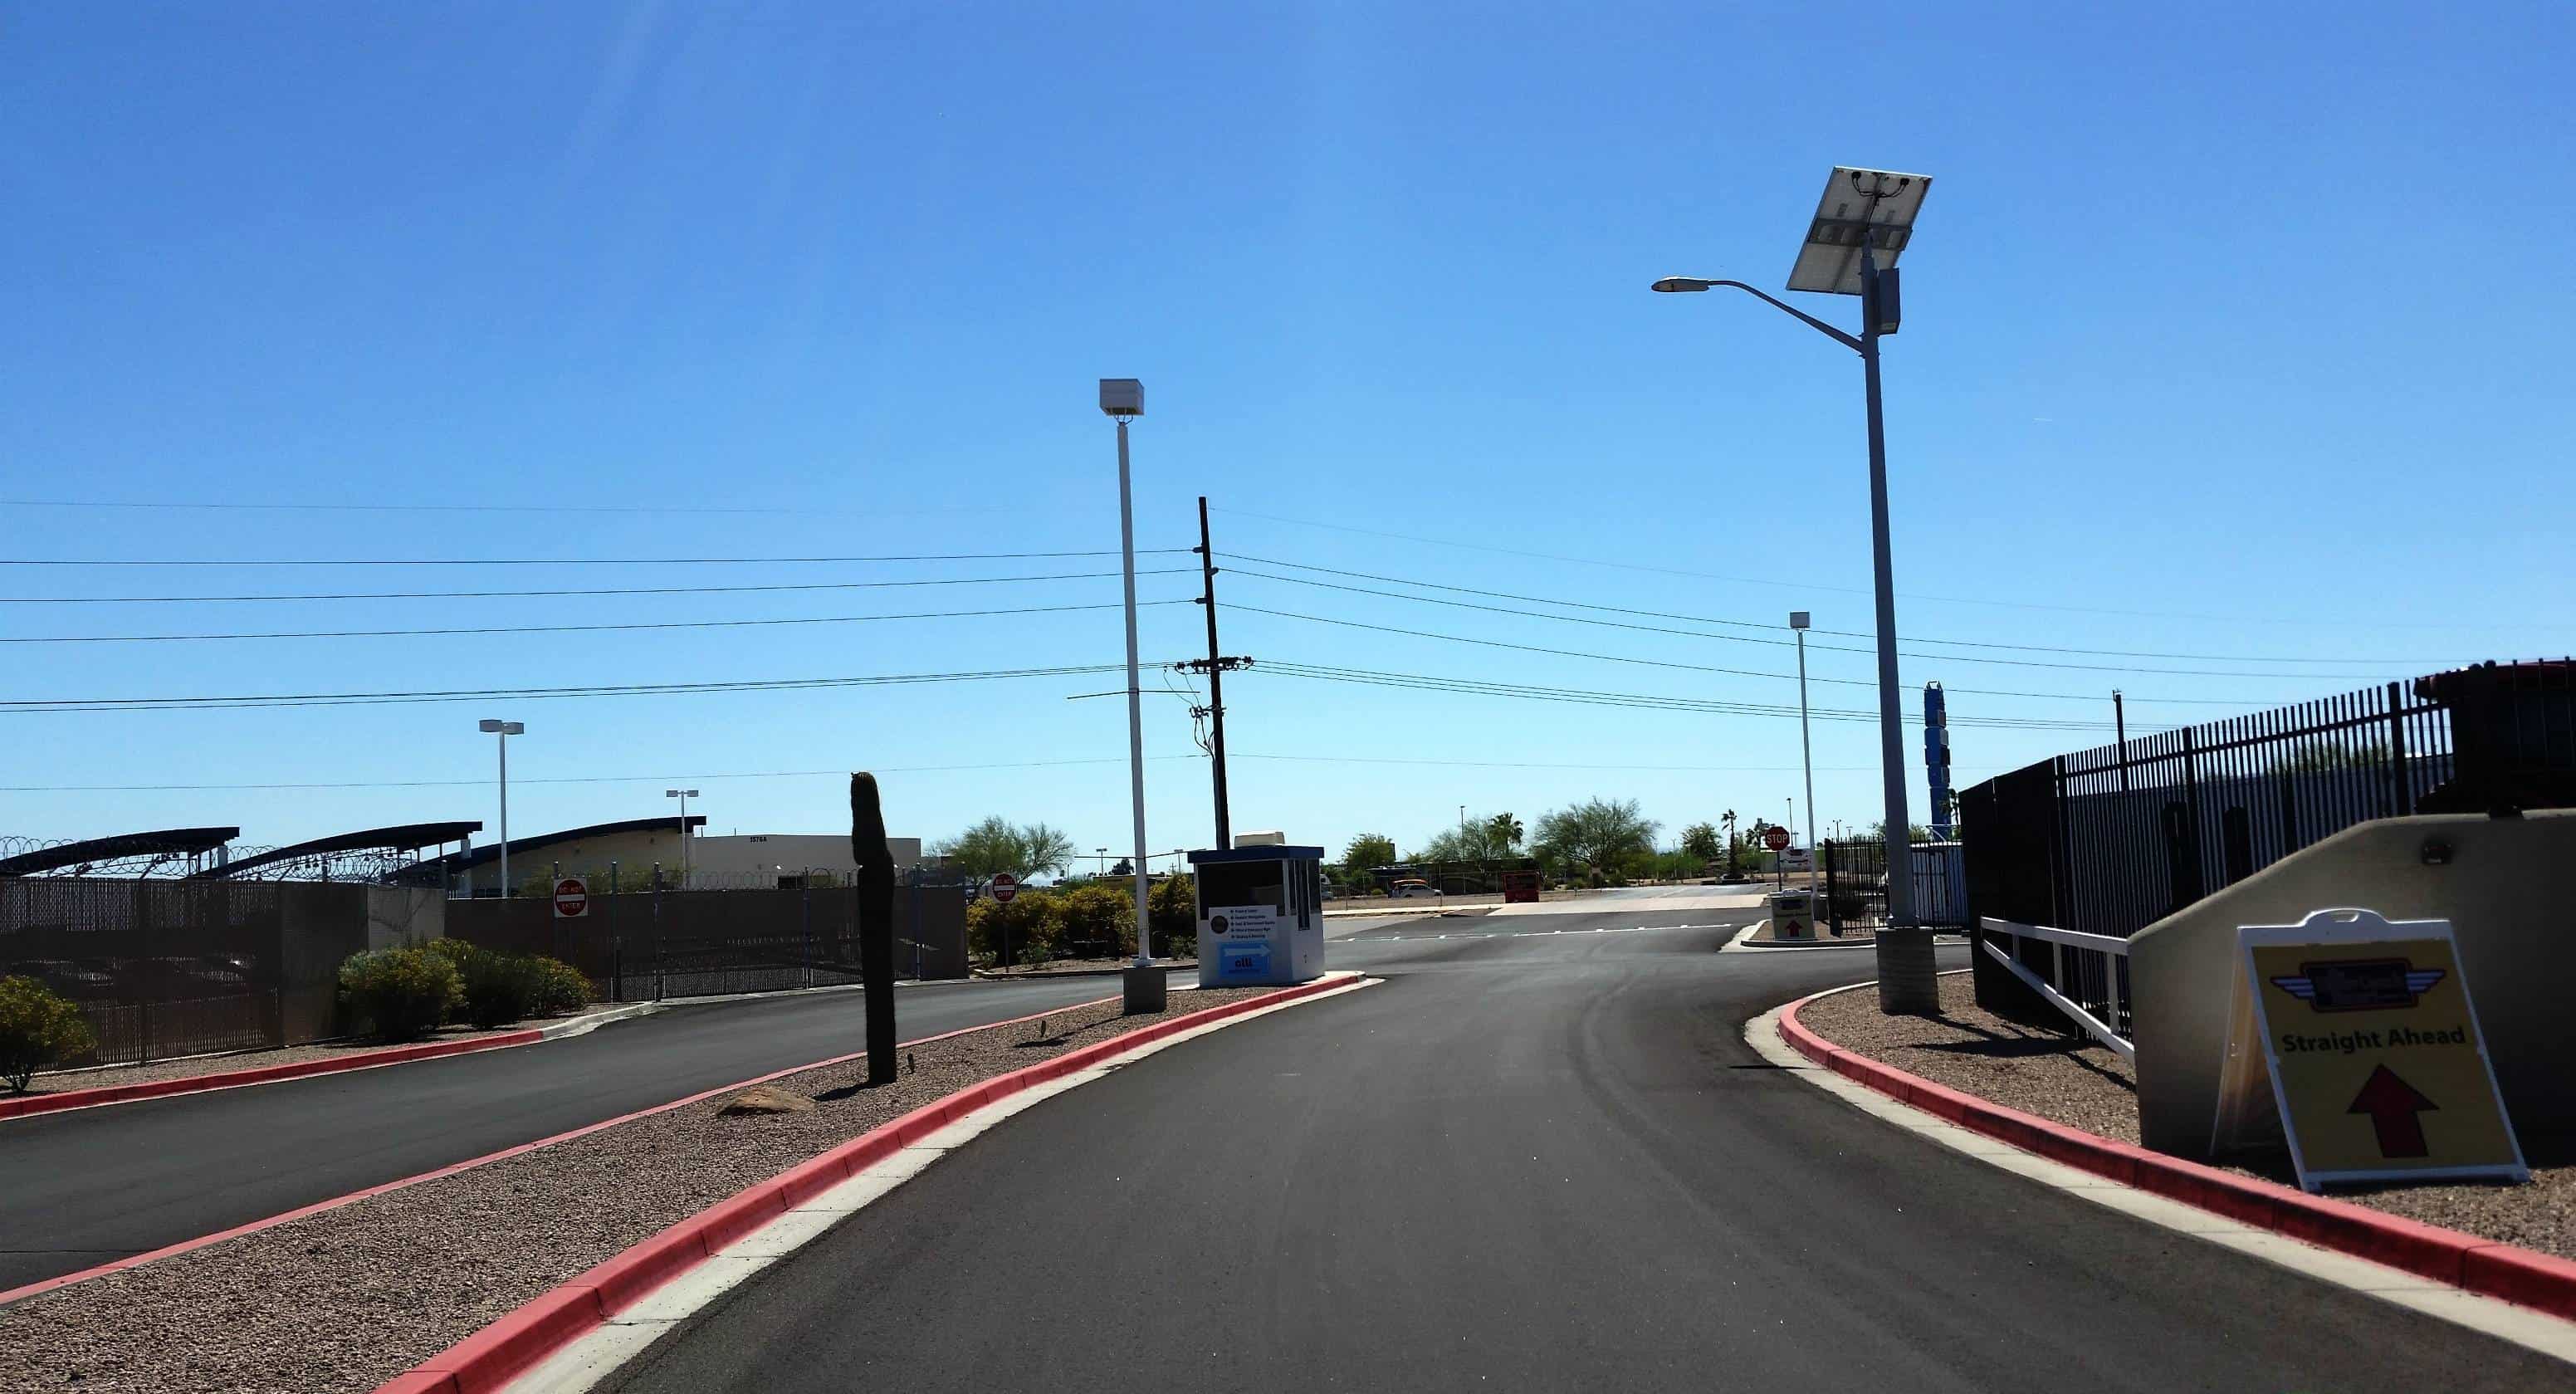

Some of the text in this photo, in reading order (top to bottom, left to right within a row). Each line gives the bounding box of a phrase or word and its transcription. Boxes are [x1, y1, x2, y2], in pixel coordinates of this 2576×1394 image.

[1767, 834, 1788, 844] STOP
[2282, 1025, 2466, 1054] Straight Ahead
